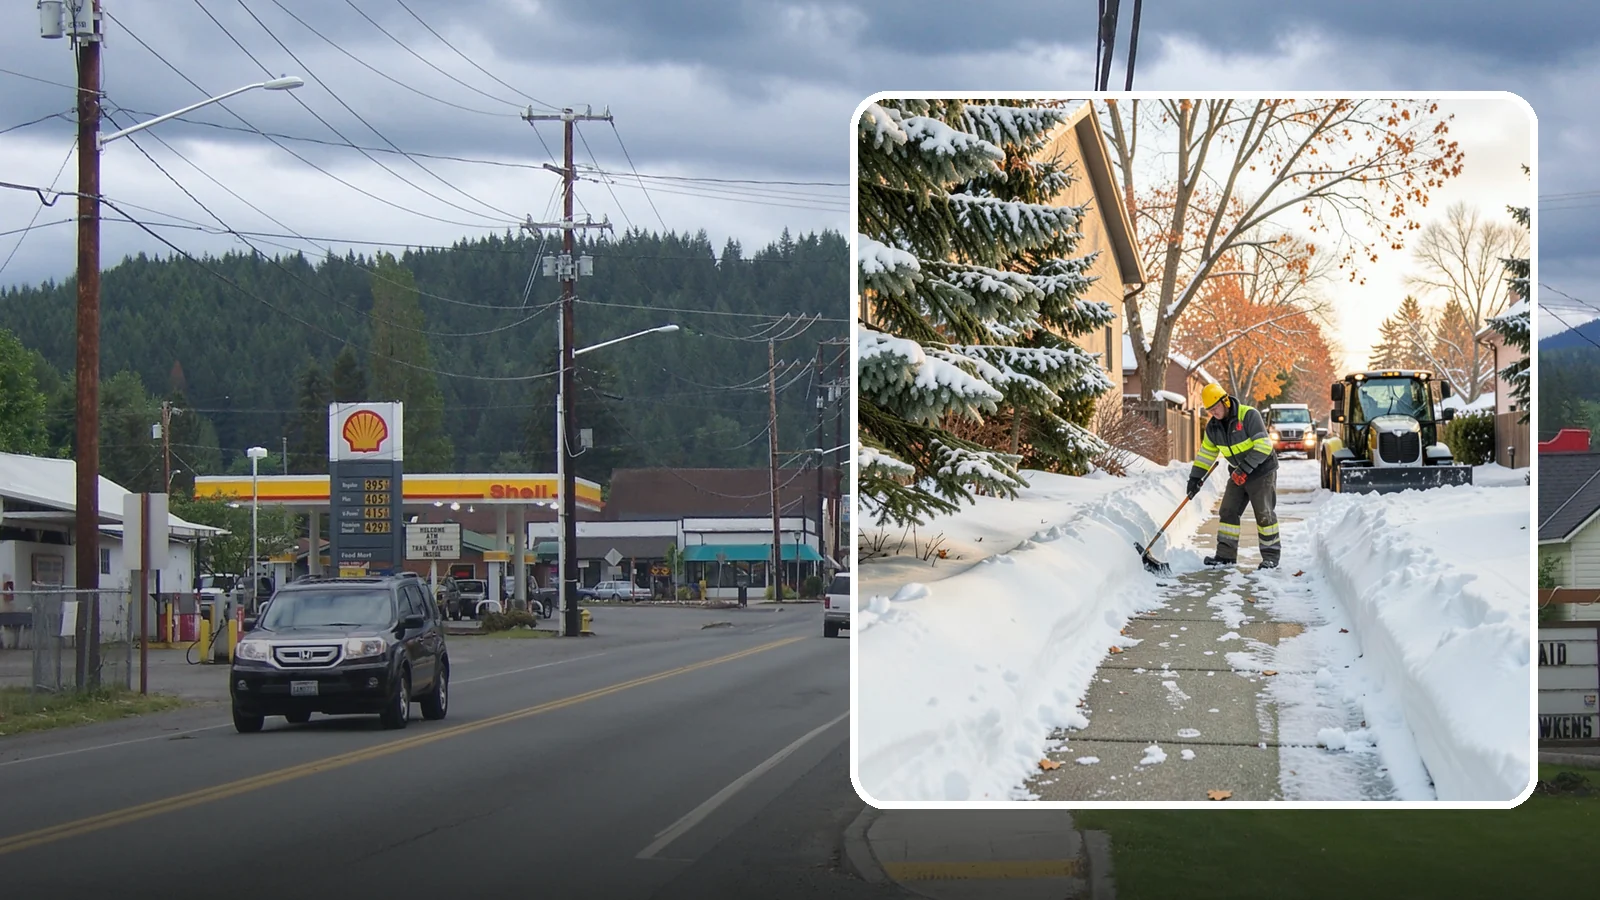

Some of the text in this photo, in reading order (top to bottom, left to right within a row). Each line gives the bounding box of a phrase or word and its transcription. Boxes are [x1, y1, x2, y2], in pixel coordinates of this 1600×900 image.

[366, 480, 383, 490] 395
[490, 484, 547, 499] Shell
[366, 494, 383, 504] 405
[366, 508, 383, 518] 415
[366, 522, 383, 532] 429
